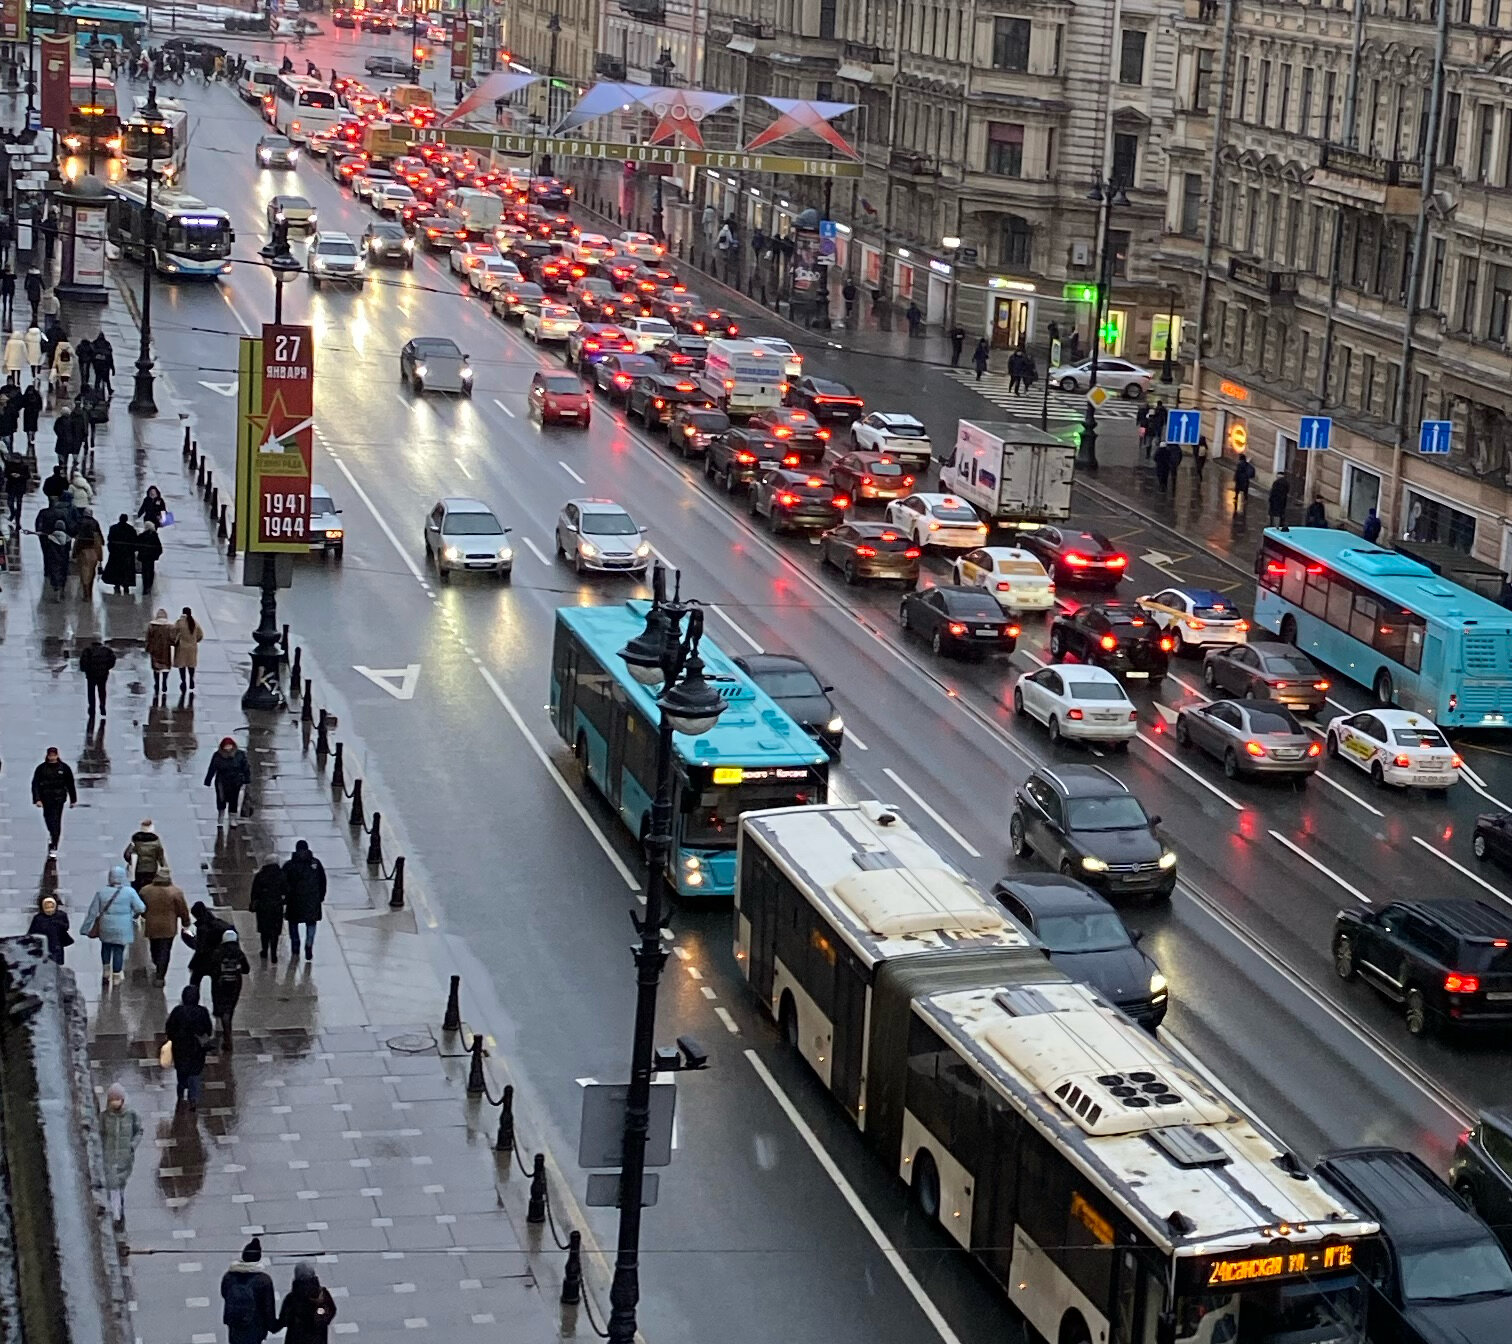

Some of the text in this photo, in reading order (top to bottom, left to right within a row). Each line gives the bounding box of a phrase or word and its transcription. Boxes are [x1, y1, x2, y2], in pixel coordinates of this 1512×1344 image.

[652, 103, 705, 121] 900
[411, 128, 447, 144] 1941
[803, 161, 837, 176] 1944
[275, 335, 301, 362] 27
[266, 366, 307, 379] ЯНВАРЯ
[264, 493, 306, 515] 1941
[263, 516, 304, 538] 1944
